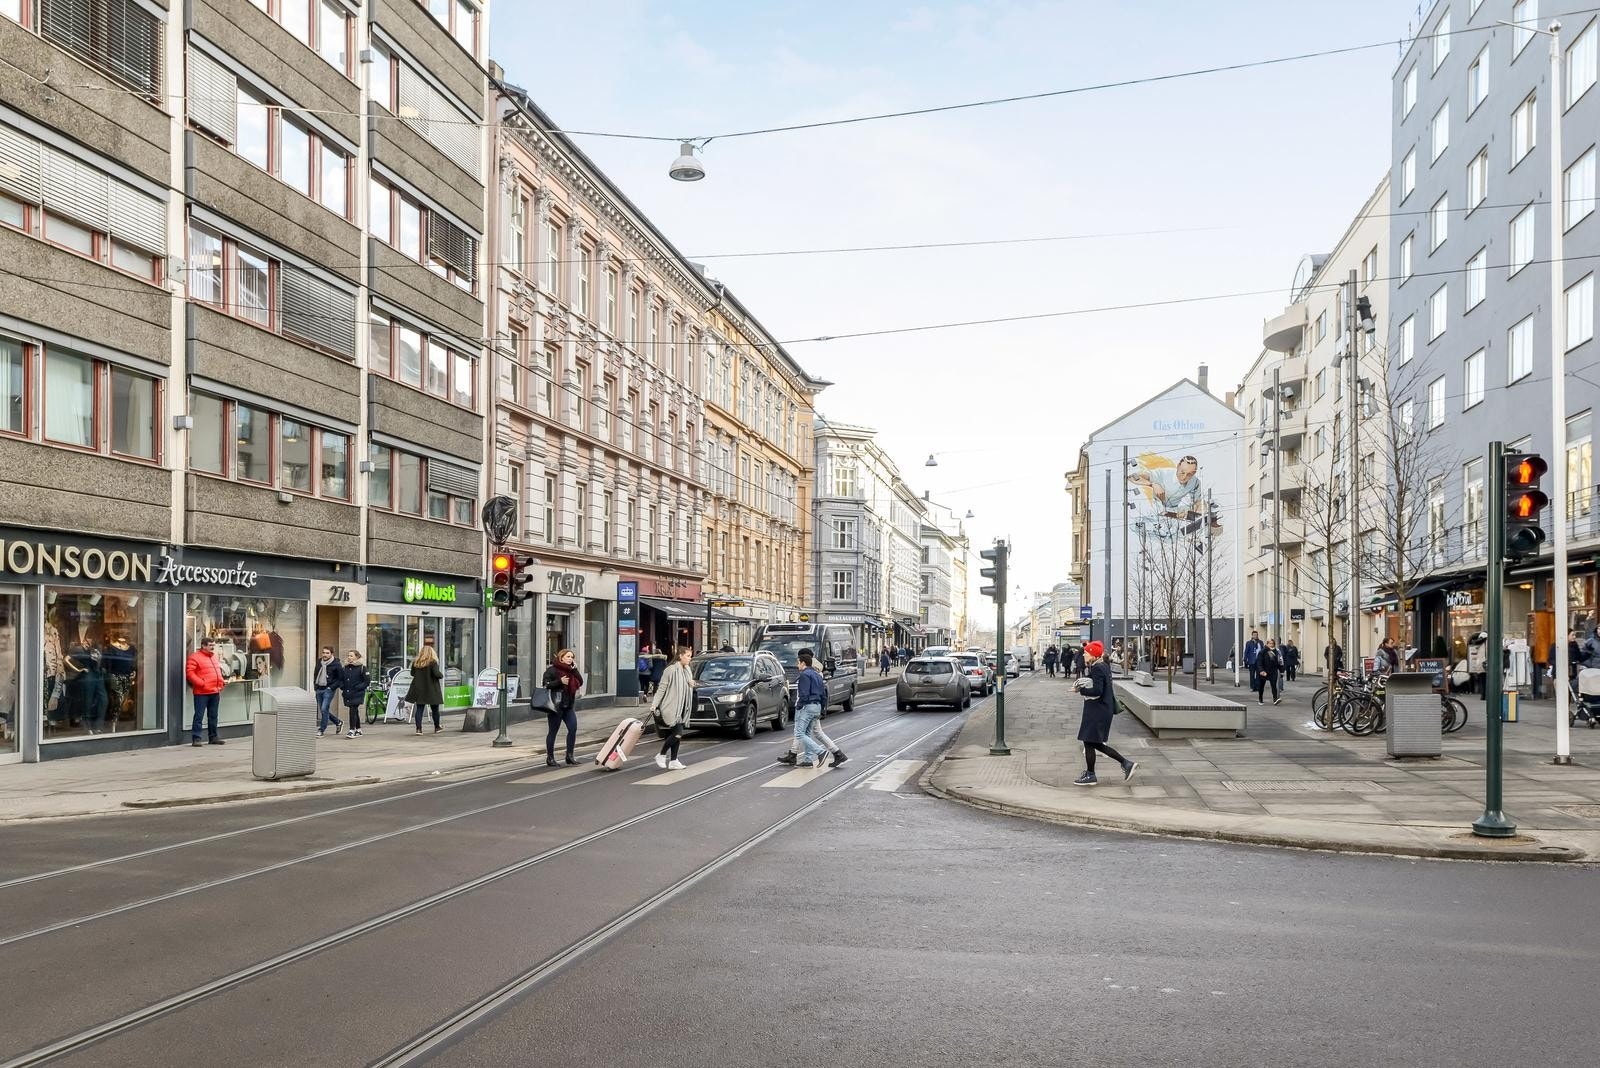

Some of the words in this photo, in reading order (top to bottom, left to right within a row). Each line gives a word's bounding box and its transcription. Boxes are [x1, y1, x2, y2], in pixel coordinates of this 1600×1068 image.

[1153, 420, 1172, 430] Clas
[1174, 419, 1205, 430] Ohlson
[160, 555, 258, 588] Accessorize
[424, 582, 457, 602] Musti
[547, 571, 585, 595] TGR
